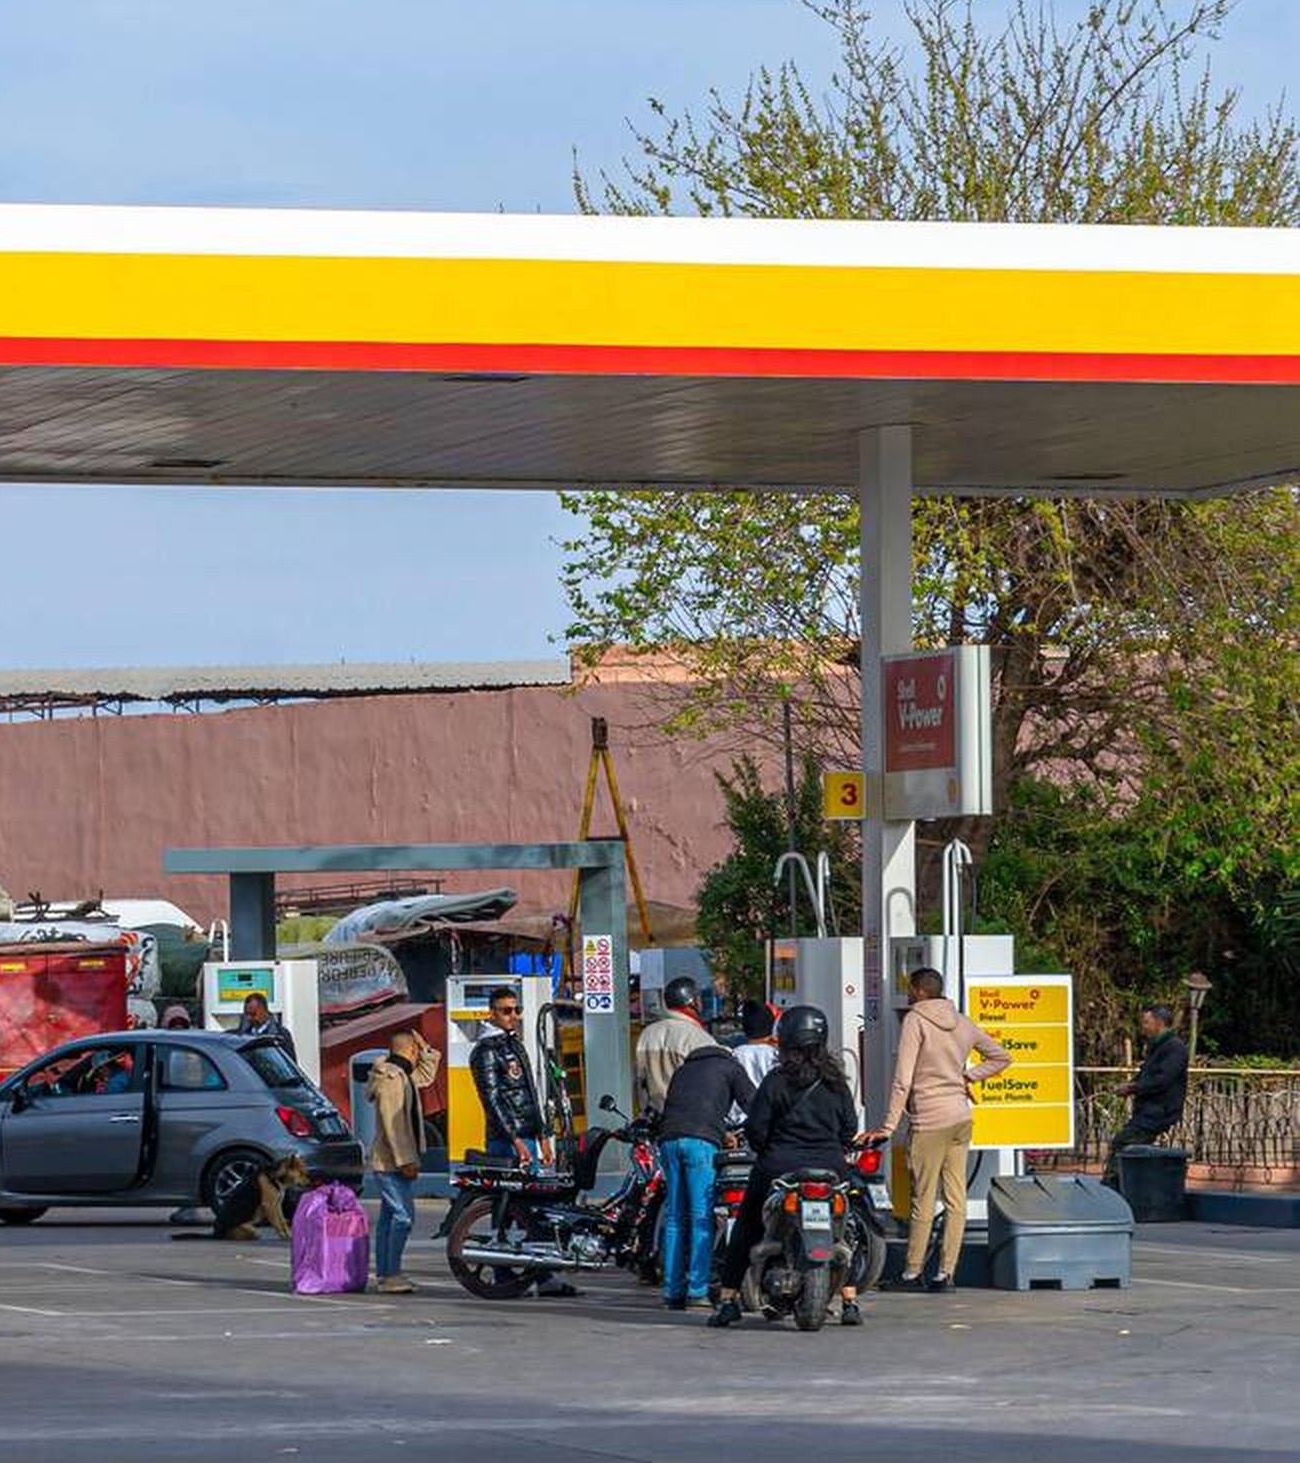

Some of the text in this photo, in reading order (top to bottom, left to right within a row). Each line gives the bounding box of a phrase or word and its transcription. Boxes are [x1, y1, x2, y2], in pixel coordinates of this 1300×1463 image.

[897, 701, 943, 730] V-Power
[841, 783, 858, 806] 3
[980, 1078, 1038, 1090] FuelSave
